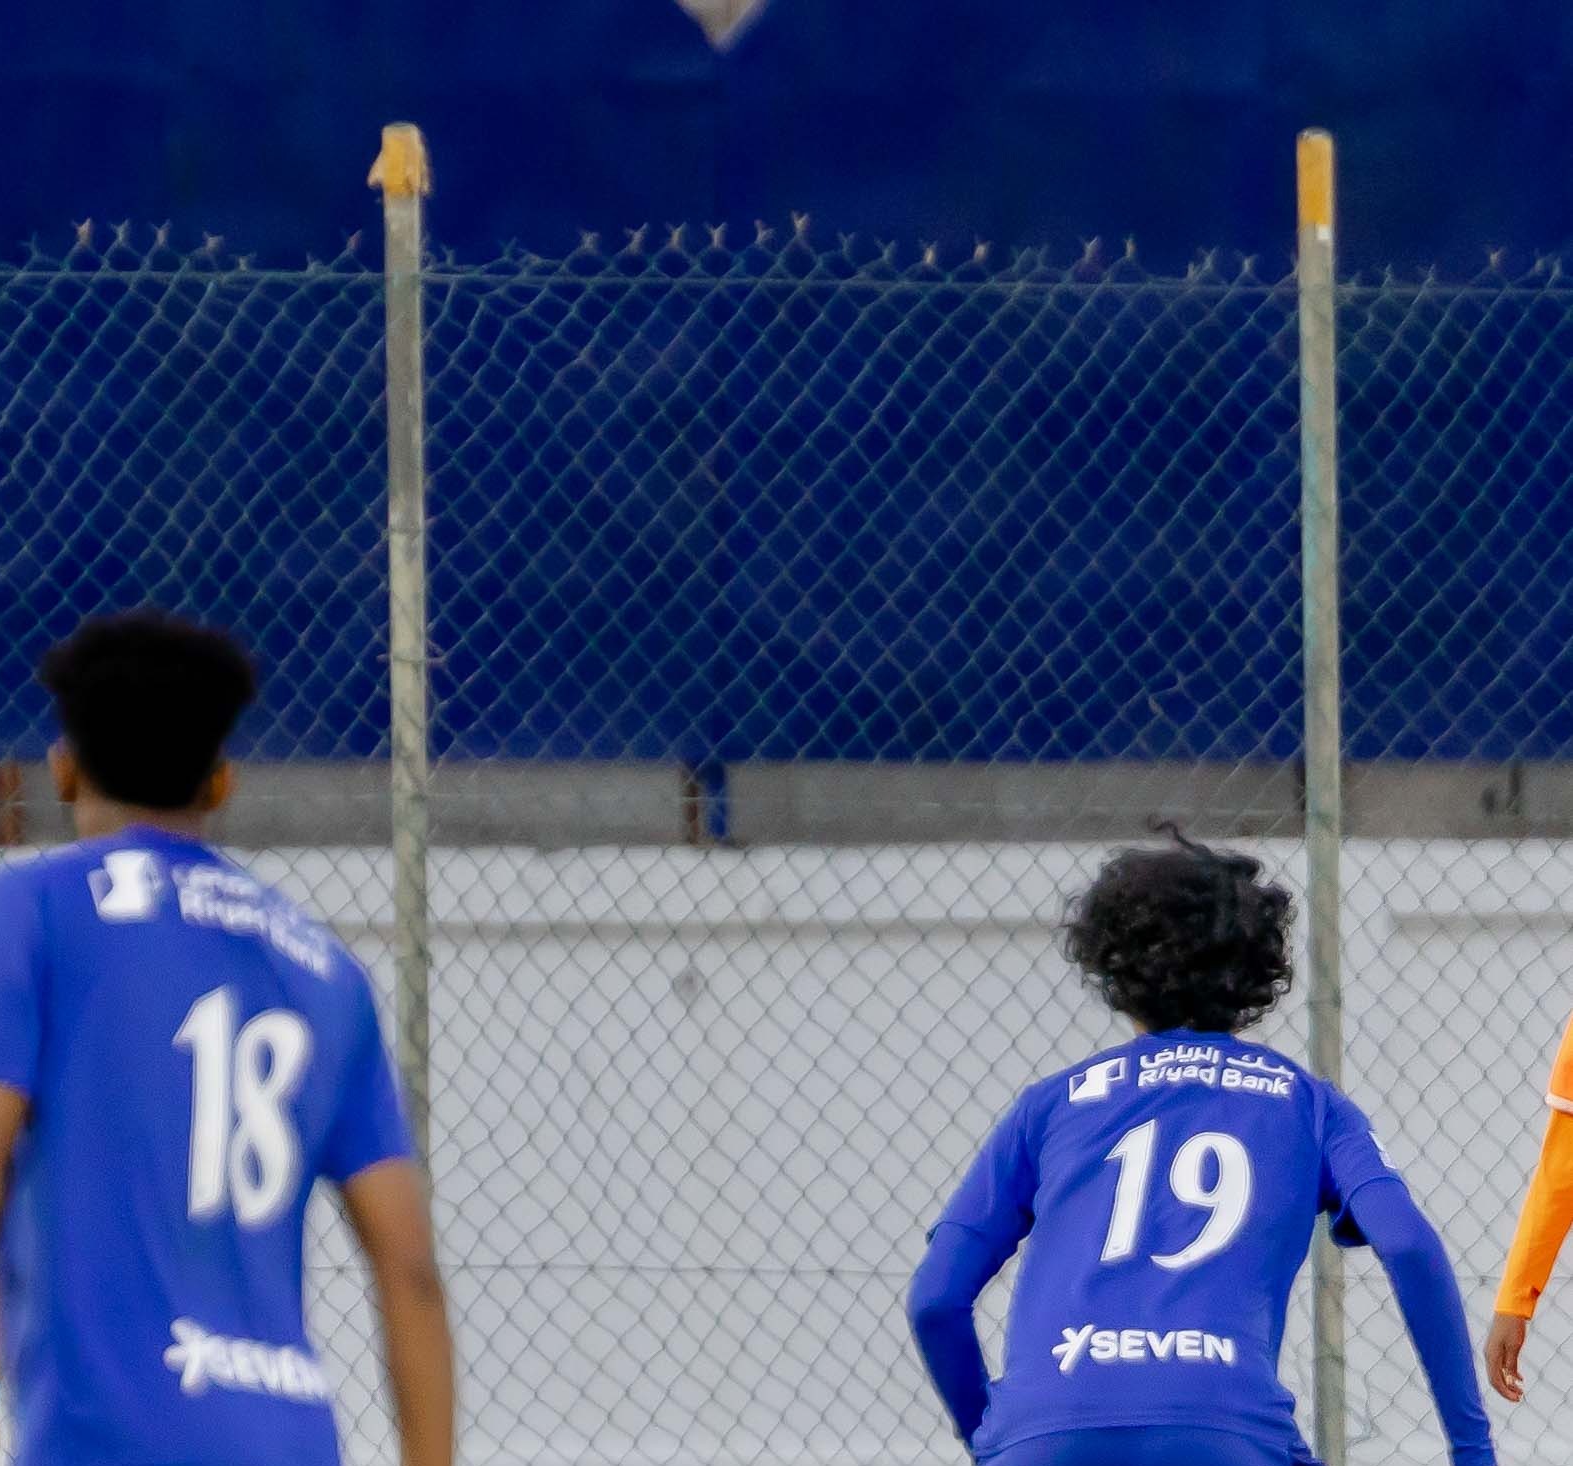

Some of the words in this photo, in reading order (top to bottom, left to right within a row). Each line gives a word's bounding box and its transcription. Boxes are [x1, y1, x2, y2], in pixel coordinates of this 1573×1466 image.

[1139, 1044, 1220, 1069] الرياض
[1226, 1053, 1295, 1081] بنك
[1137, 1064, 1214, 1088] Riyad
[1221, 1067, 1291, 1096] Bank
[174, 986, 310, 1226] 18
[1100, 1119, 1251, 1269] 19
[1088, 1329, 1235, 1363] SEVEN
